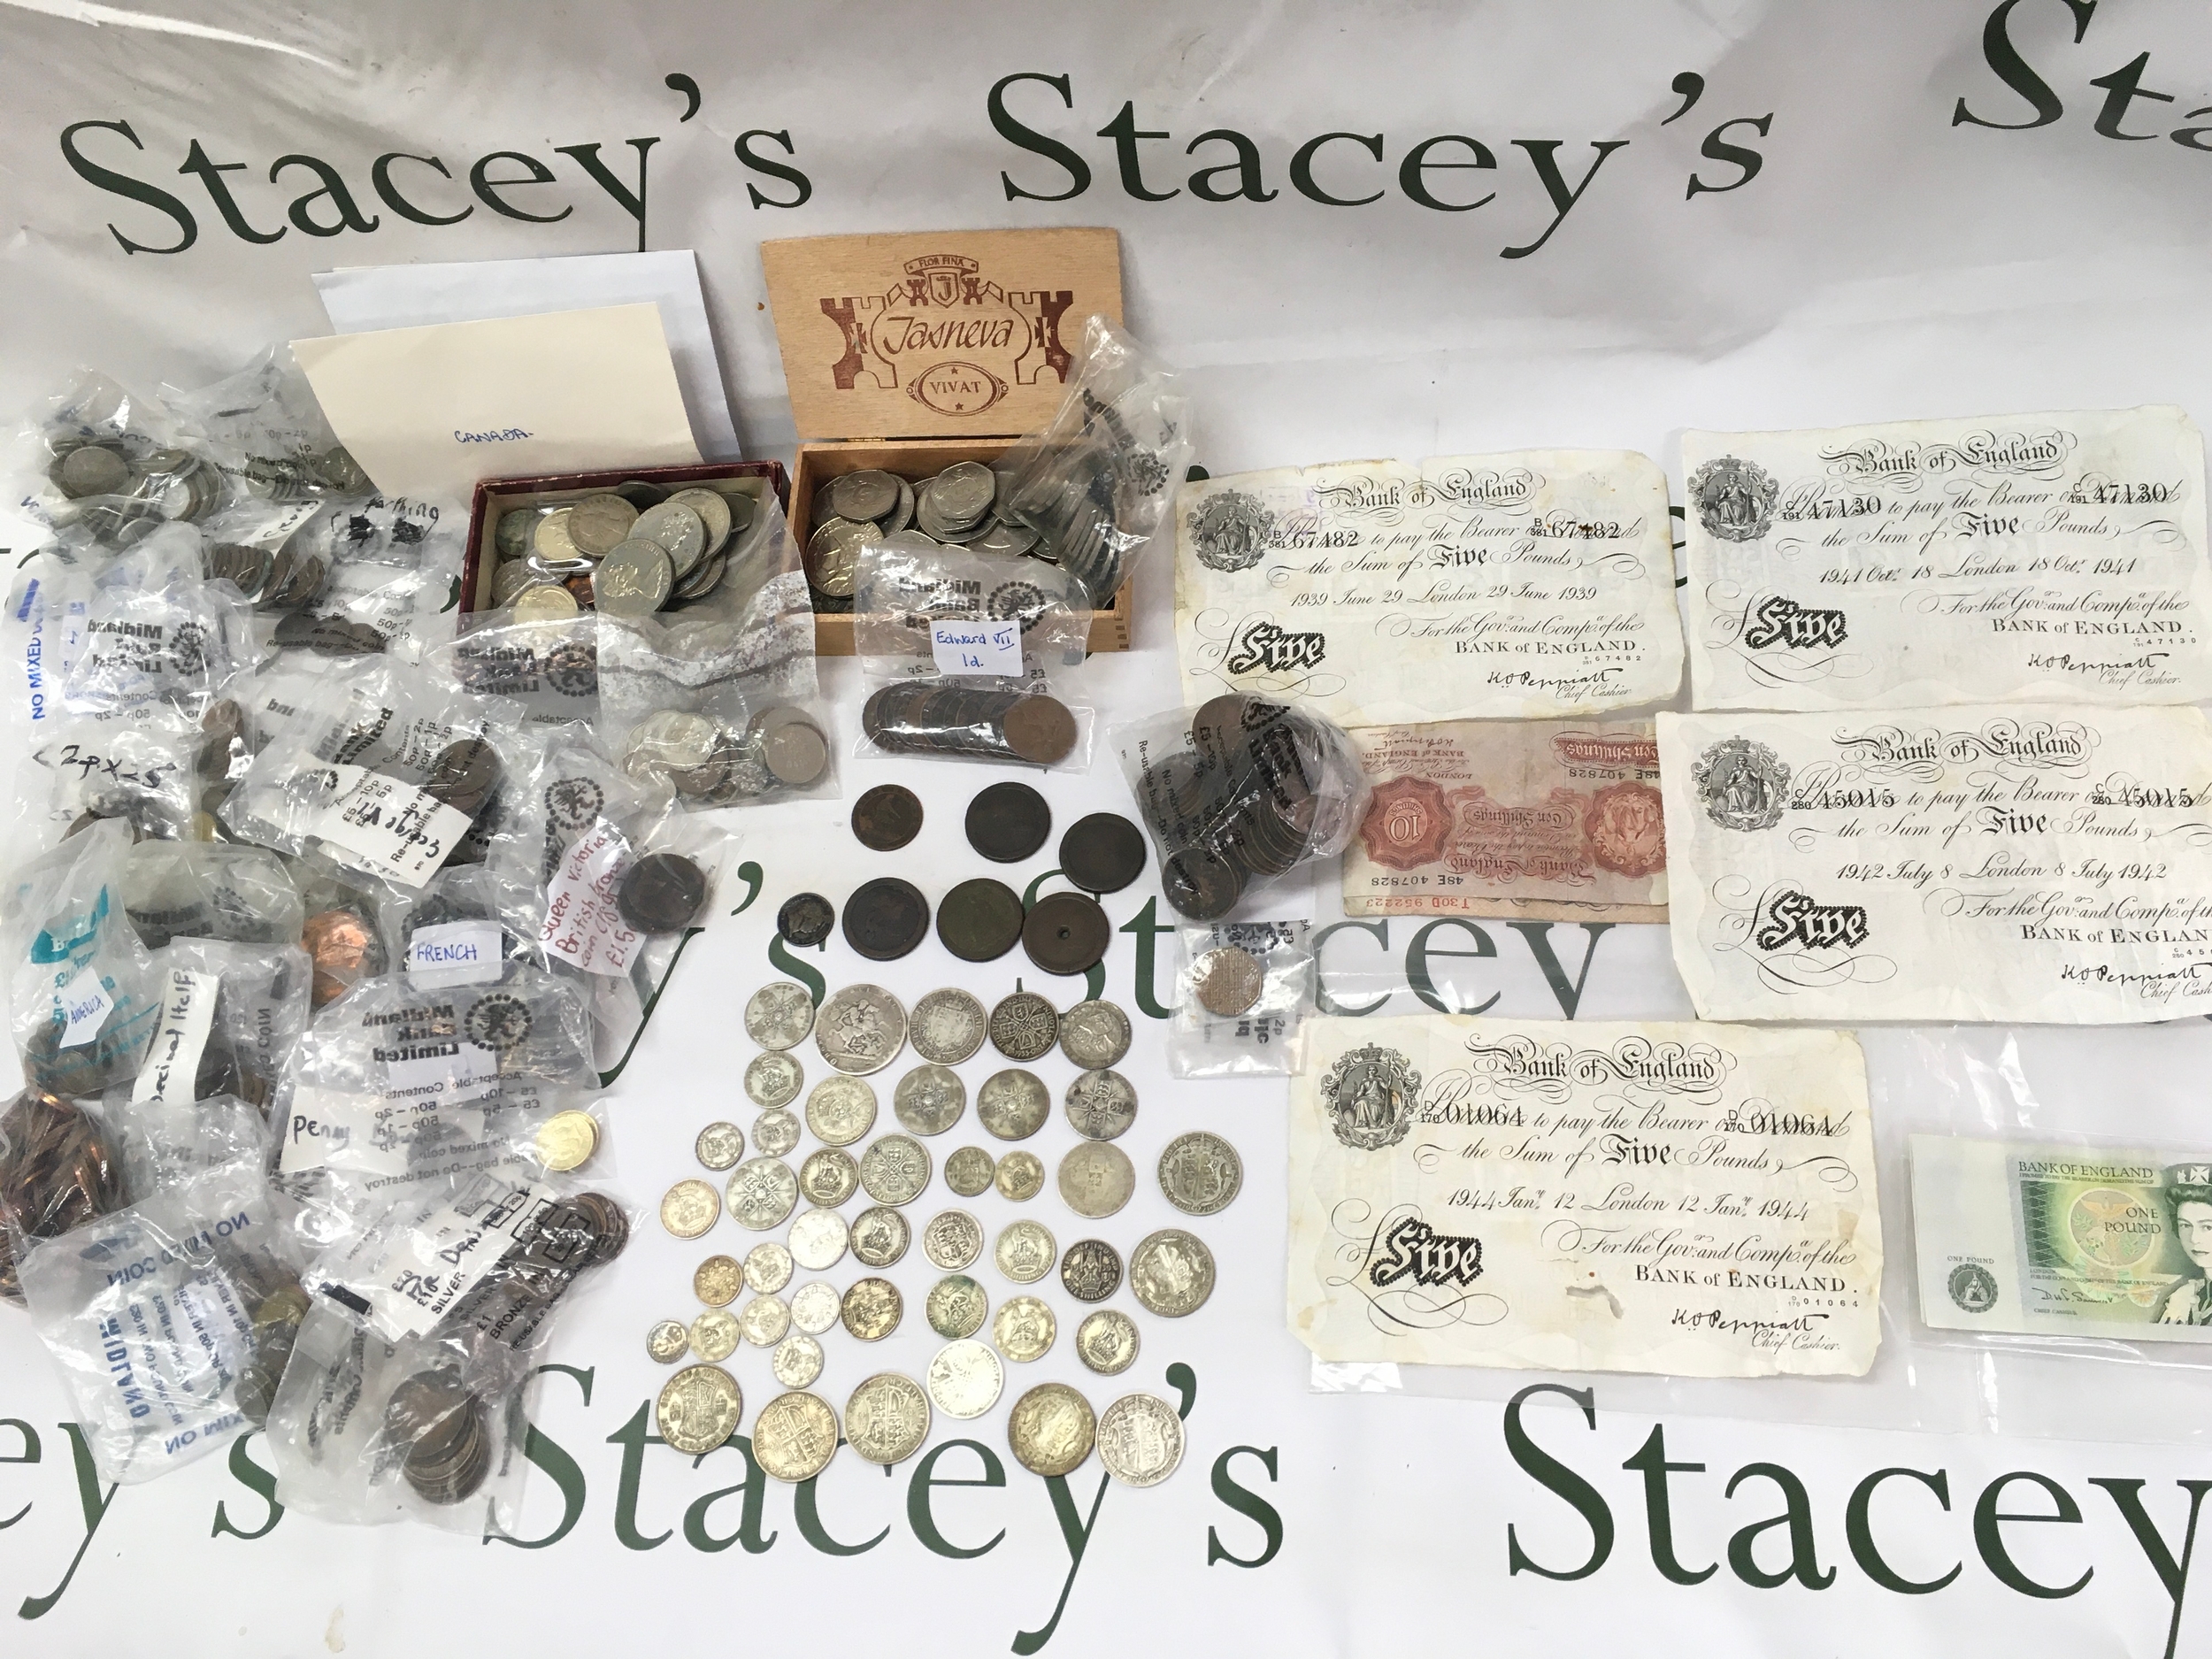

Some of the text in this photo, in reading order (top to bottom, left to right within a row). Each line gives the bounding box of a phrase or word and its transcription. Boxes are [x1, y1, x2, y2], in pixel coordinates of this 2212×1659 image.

[60, 73, 815, 256] Stacey's
[987, 73, 1772, 258] Stacey's
[918, 257, 964, 268] FLOR FINA
[883, 316, 1014, 355] Jasneva
[929, 380, 981, 395] VIVAT
[1370, 533, 1382, 546] to
[1383, 530, 1425, 552] pay
[1425, 519, 1455, 541] the
[1460, 514, 1520, 541] Bearer
[1820, 527, 1851, 549] the
[1857, 520, 1912, 546] Sum
[1919, 517, 1947, 557] of
[1952, 511, 2022, 541] Five
[1305, 557, 1335, 575] the
[1341, 551, 1393, 573] Sum
[1397, 549, 1423, 582] of
[1429, 543, 1488, 570] Five
[1817, 550, 2139, 586] 1941 18 London 18 1941
[1289, 579, 1598, 608] 1939 June 29 London 29 June 1939
[936, 630, 987, 646] Edward
[1992, 618, 2048, 634] BANK
[2054, 618, 2070, 634] of
[1454, 641, 1511, 655] BANK
[1515, 640, 1530, 654] of
[31, 694, 45, 720] NO
[1569, 768, 1626, 780] 407828
[1389, 815, 1421, 841] 10
[1837, 818, 1869, 838] the
[1875, 812, 1933, 837] Sum
[1942, 810, 1972, 849] of
[1976, 806, 2047, 836] Five
[1371, 874, 1464, 886] 48E 407828
[1836, 850, 2167, 889] 1942 July 8 London 8 July 1942
[1366, 897, 1423, 908] 952223
[555, 899, 595, 954] British
[2019, 925, 2084, 942] BANK
[2086, 929, 2104, 943] of
[417, 944, 478, 962] FRENCH
[1533, 1111, 1550, 1128] to
[1548, 1110, 1599, 1138] pay
[1597, 1110, 1629, 1130] the
[1638, 1098, 1709, 1131] Bearer
[1459, 1137, 1494, 1160] the
[1500, 1133, 1560, 1164] Sum
[1564, 1136, 1596, 1179] of
[1600, 1133, 1671, 1166] Five
[2018, 1161, 2059, 1173] BANK
[2060, 1164, 2078, 1175] OF
[2081, 1165, 2154, 1179] ENGLAND
[1446, 1182, 1810, 1222] 1944 12 London 12 1944
[2125, 1207, 2159, 1219] ONE
[2104, 1221, 2162, 1235] POUND
[1966, 1256, 1995, 1264] POUND
[1634, 1263, 1698, 1284] BANK
[1703, 1273, 1722, 1287] of
[430, 1271, 466, 1316] SILVER
[489, 1293, 532, 1341] BRONZE
[484, 1361, 1285, 1655] Stacey's
